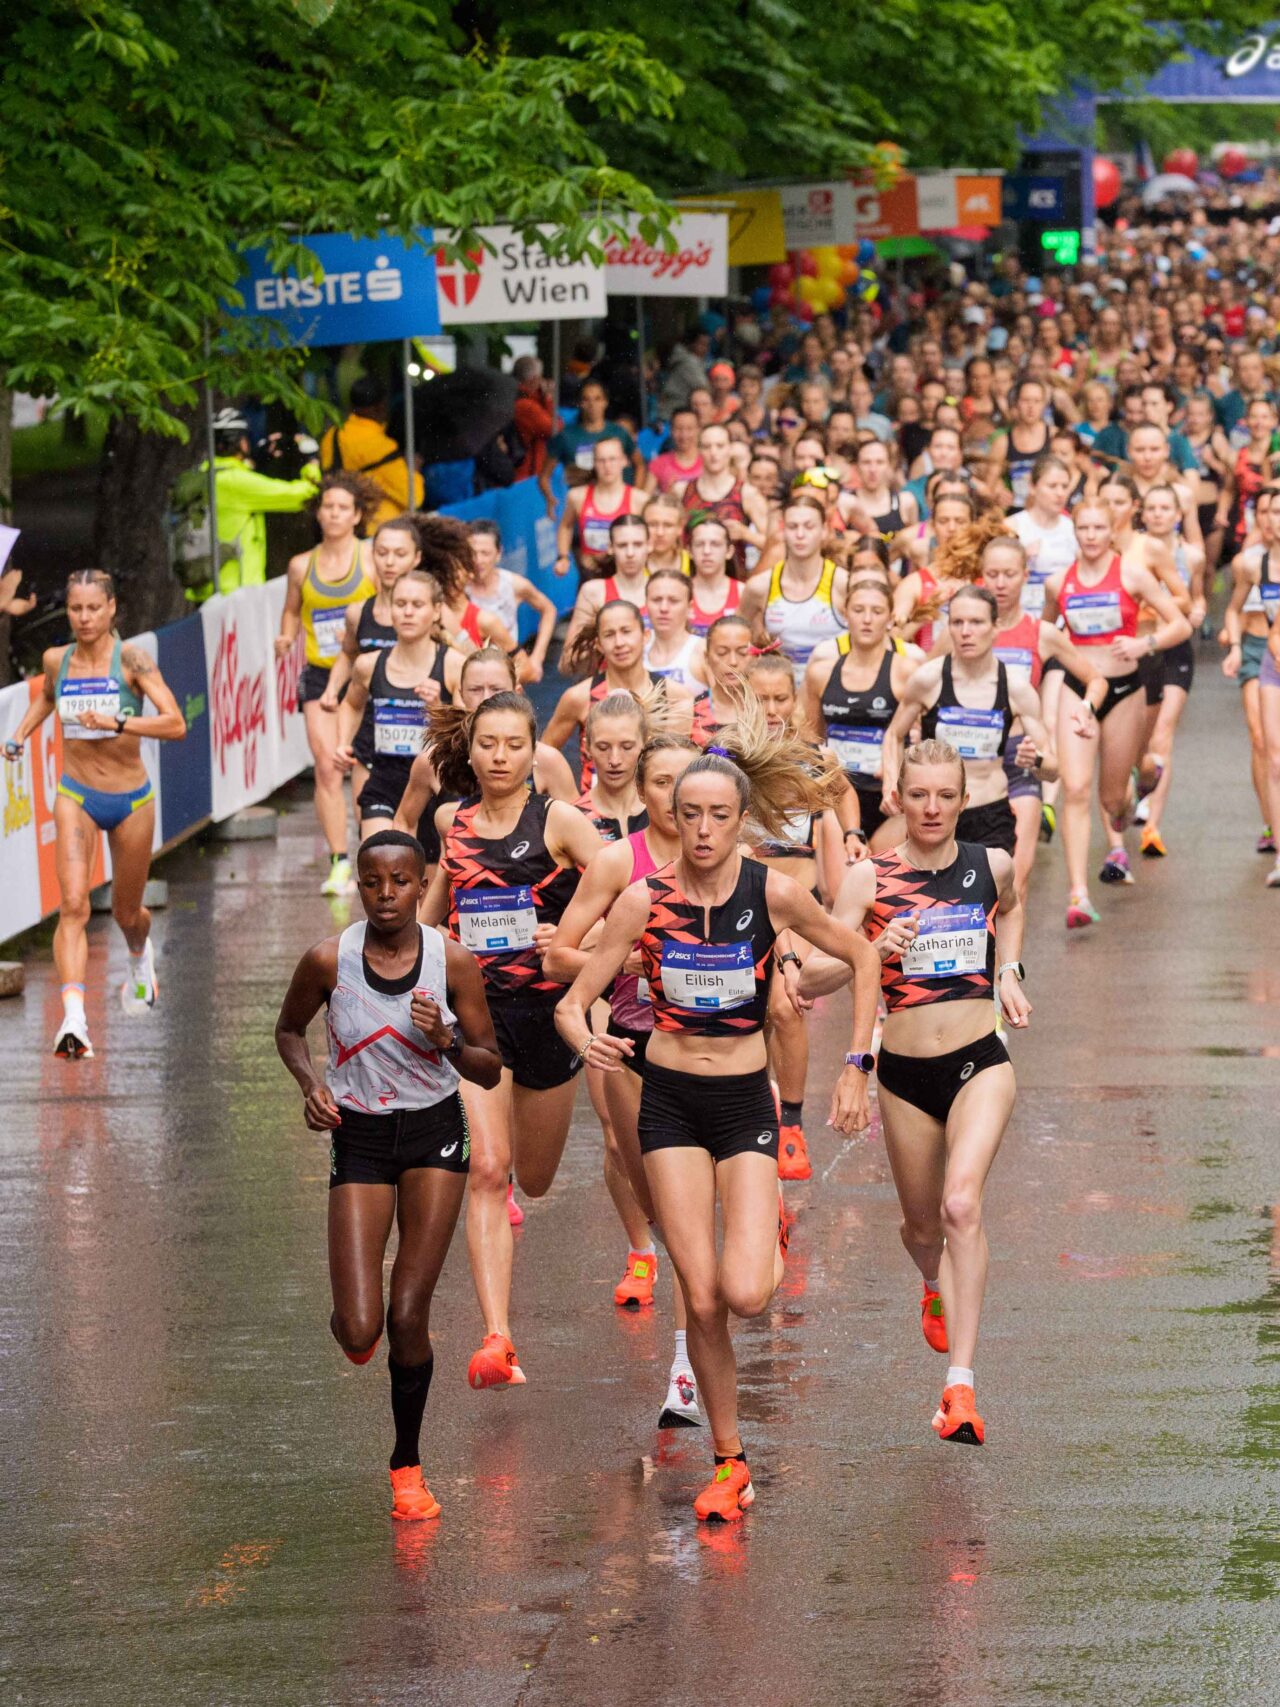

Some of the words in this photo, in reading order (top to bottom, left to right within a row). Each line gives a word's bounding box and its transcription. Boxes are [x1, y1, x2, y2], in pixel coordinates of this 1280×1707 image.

[254, 271, 363, 311] ERSTE
[503, 275, 590, 305] Wien
[66, 699, 97, 711] 19891
[380, 728, 417, 741] 15072
[470, 914, 517, 928] Melanie
[908, 935, 974, 953] Katharina
[685, 973, 724, 987] Eilish
